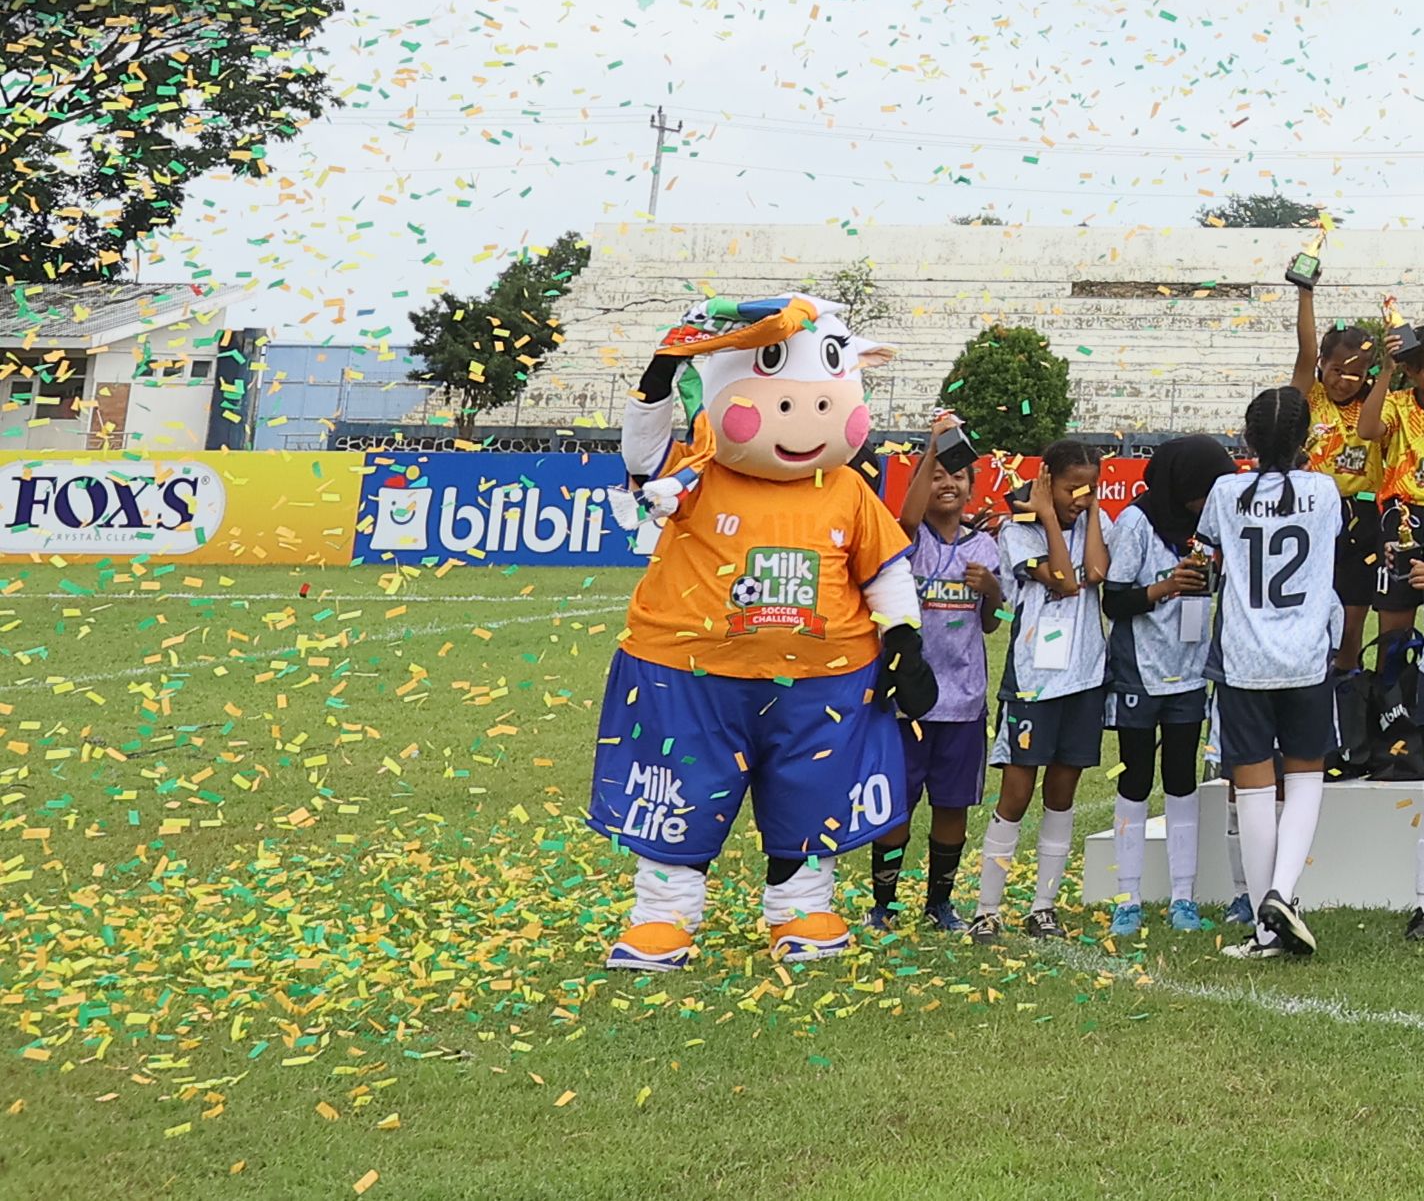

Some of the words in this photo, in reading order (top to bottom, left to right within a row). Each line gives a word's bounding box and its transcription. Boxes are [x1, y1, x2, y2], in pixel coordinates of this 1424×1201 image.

[5, 475, 200, 531] FOX'S
[439, 486, 607, 553] blibli
[105, 532, 148, 542] CLEA
[715, 513, 741, 537] 10
[754, 552, 813, 579] Milk
[1240, 524, 1310, 610] 12
[762, 578, 815, 605] Life
[752, 614, 804, 626] CHALLENGE
[760, 606, 798, 616] SOCCER
[624, 761, 686, 809] Milk
[848, 772, 892, 833] 10
[622, 799, 688, 844] Life
